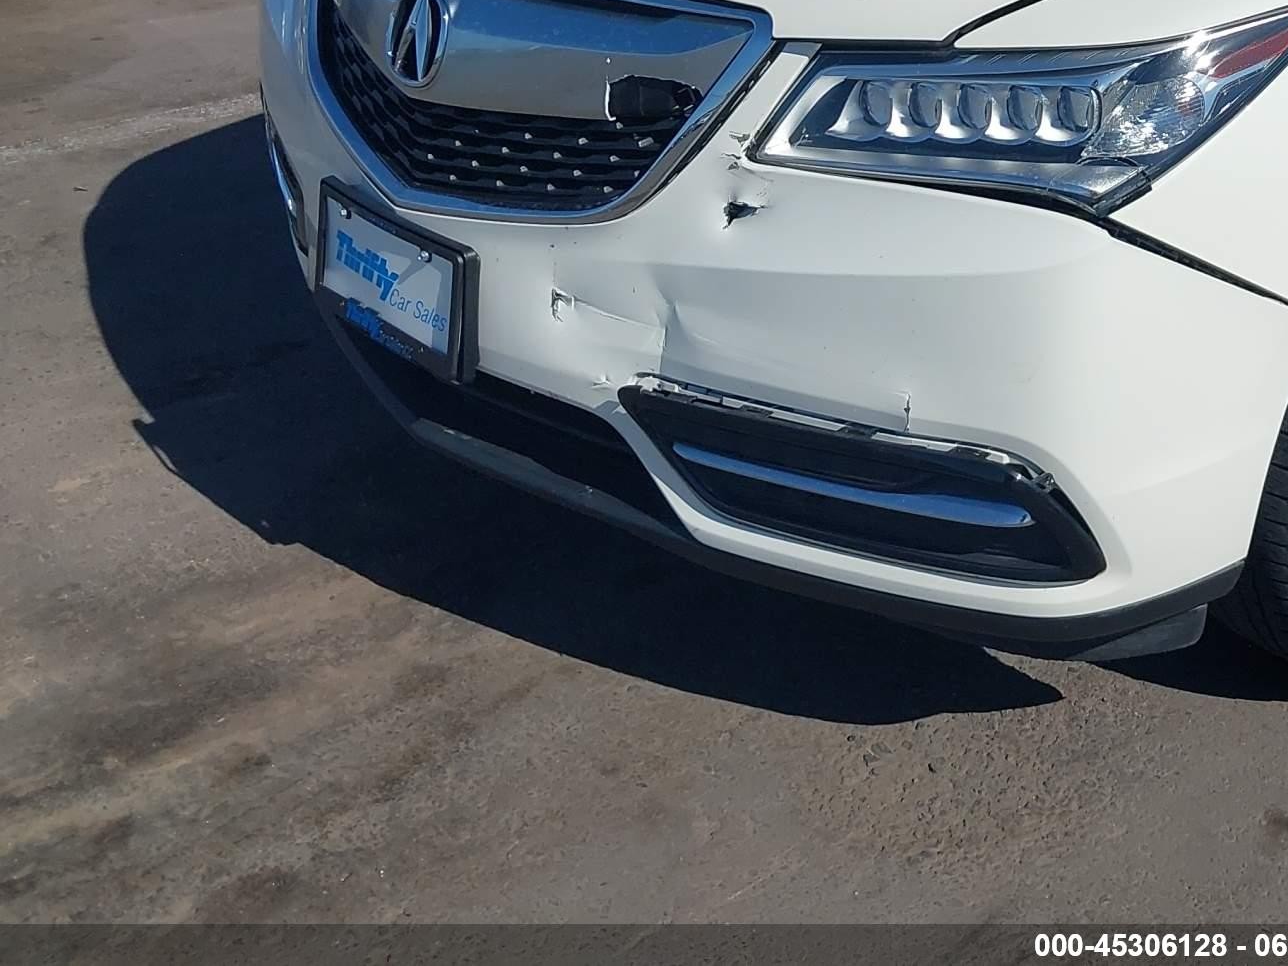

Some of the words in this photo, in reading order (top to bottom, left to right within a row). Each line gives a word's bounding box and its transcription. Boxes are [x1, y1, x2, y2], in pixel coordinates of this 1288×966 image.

[336, 229, 400, 302] Thrifty
[388, 288, 412, 314] Car
[413, 299, 448, 333] Sales
